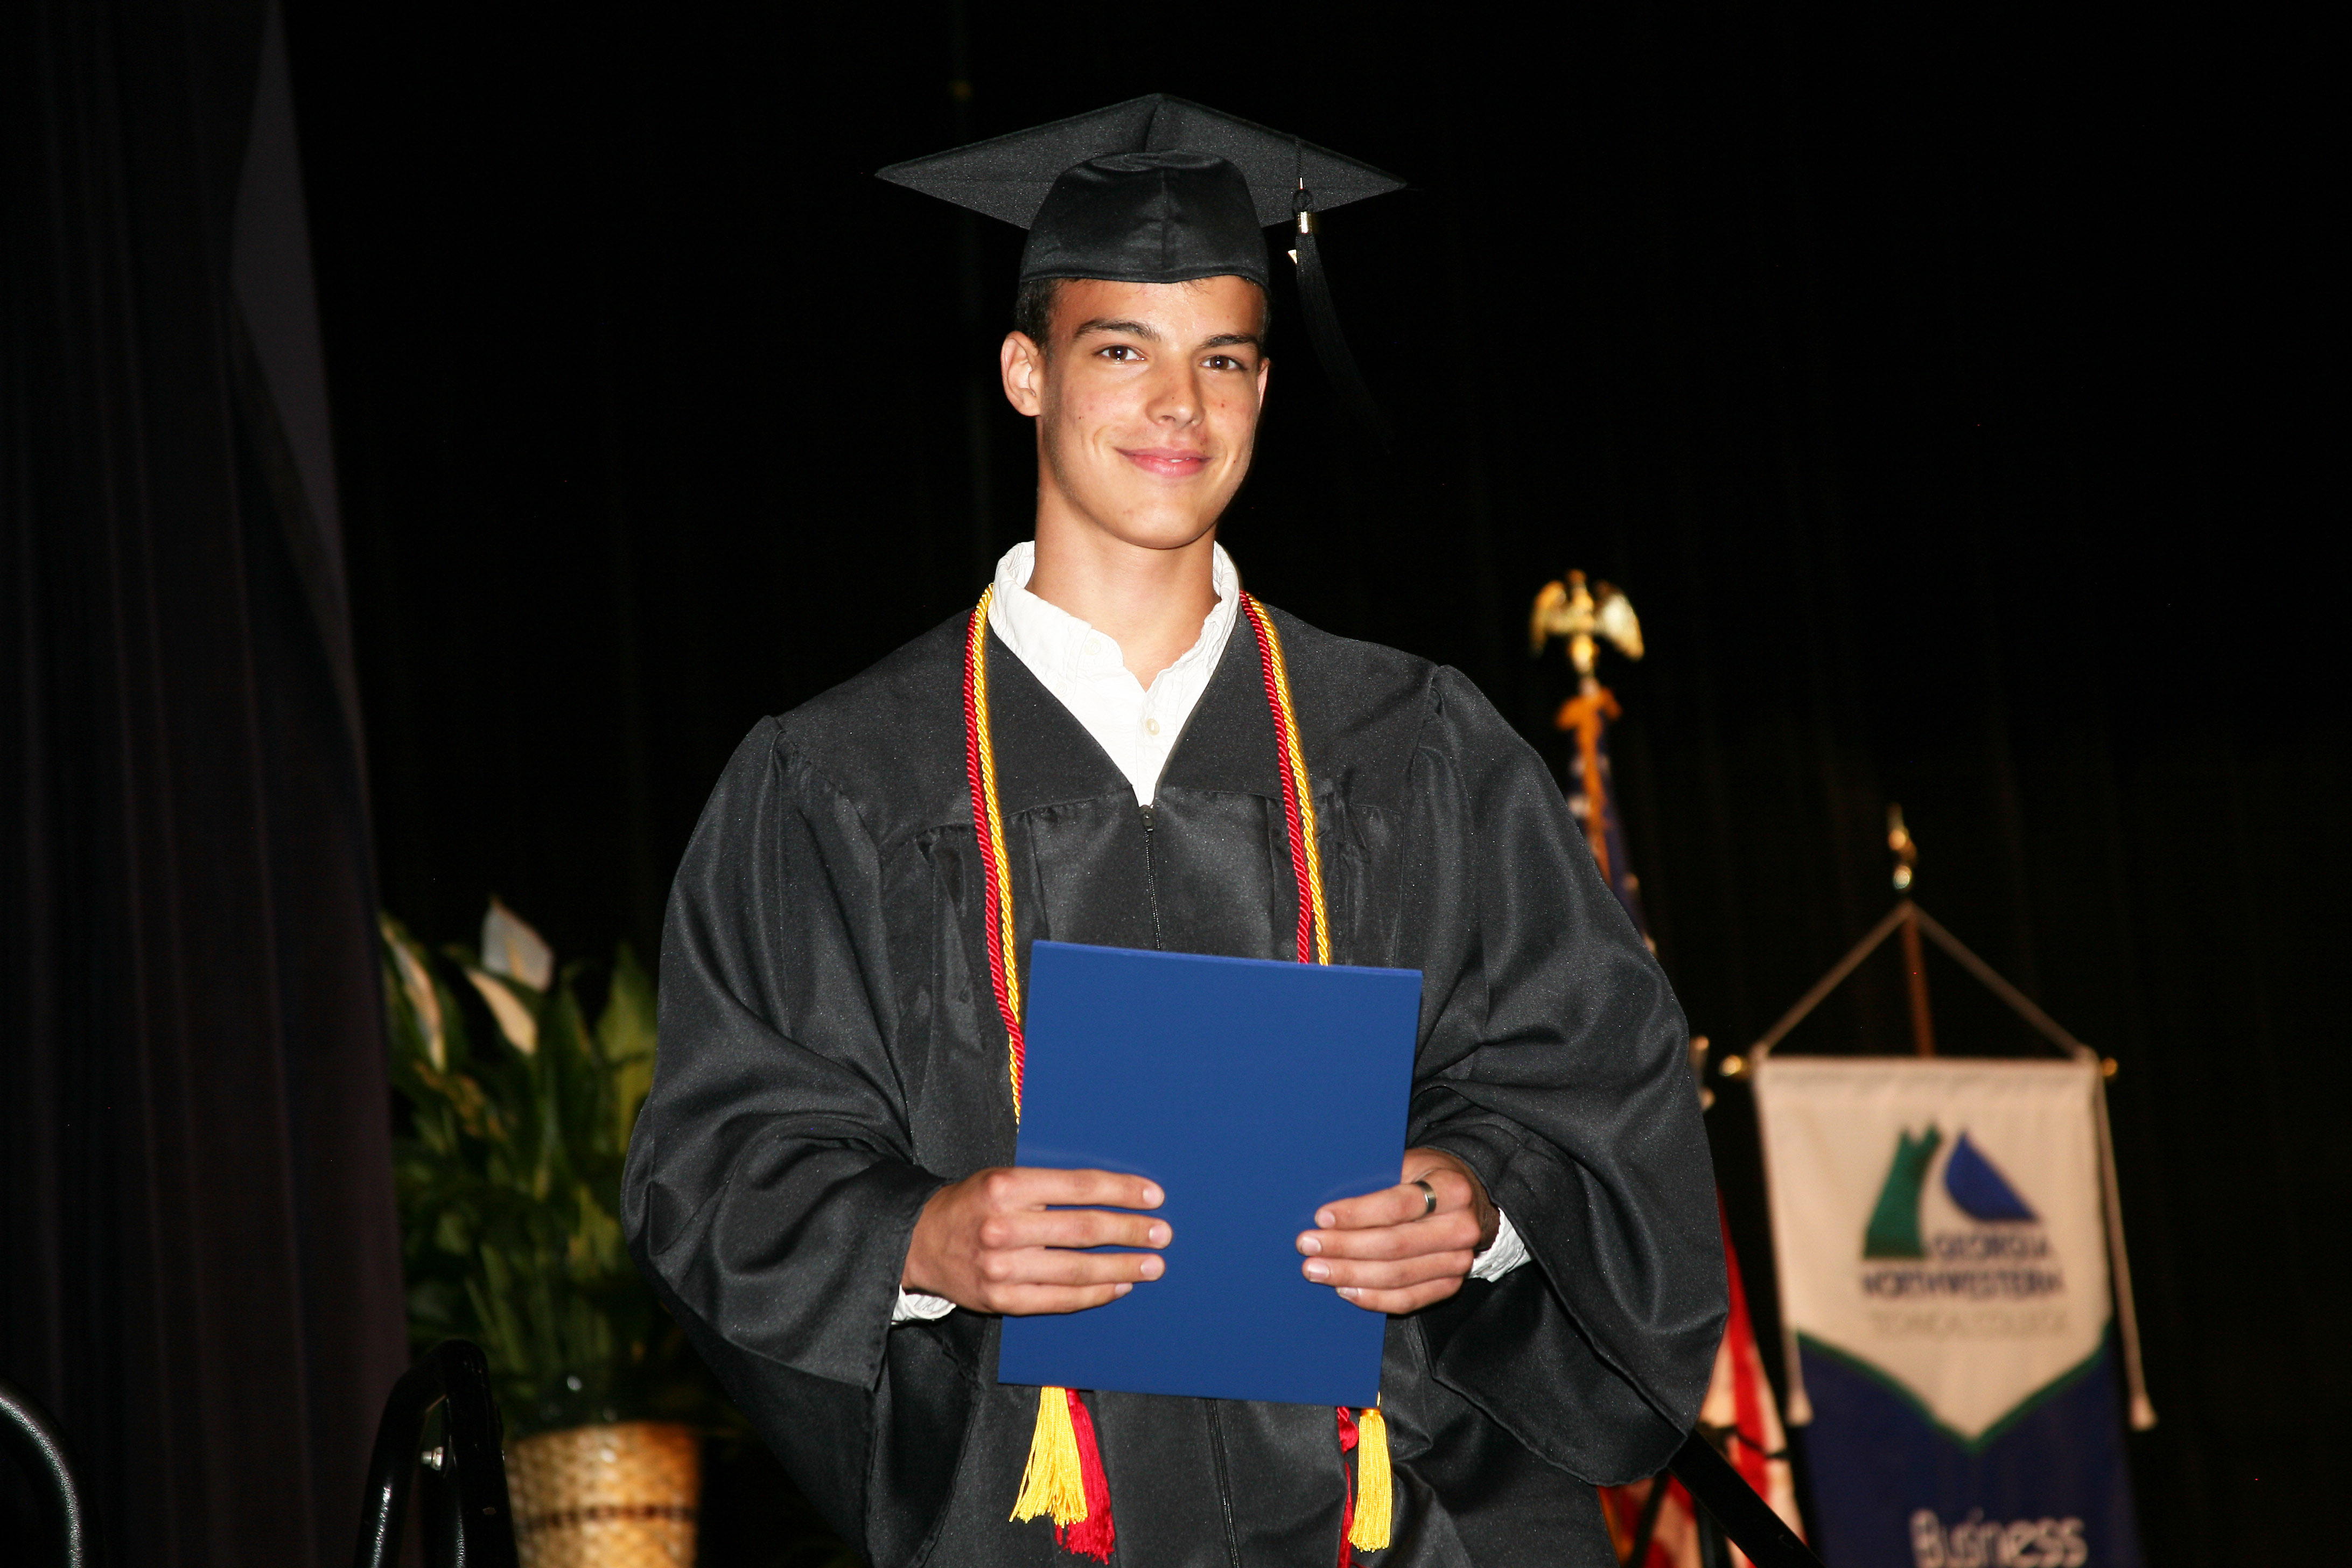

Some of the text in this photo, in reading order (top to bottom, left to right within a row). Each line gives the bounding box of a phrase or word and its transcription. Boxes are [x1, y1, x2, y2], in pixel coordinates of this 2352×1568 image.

[1930, 1234, 2052, 1261] GEORGIA
[1863, 1269, 2065, 1299] NORTHWESTERN
[1910, 1508, 2087, 1568] Business
